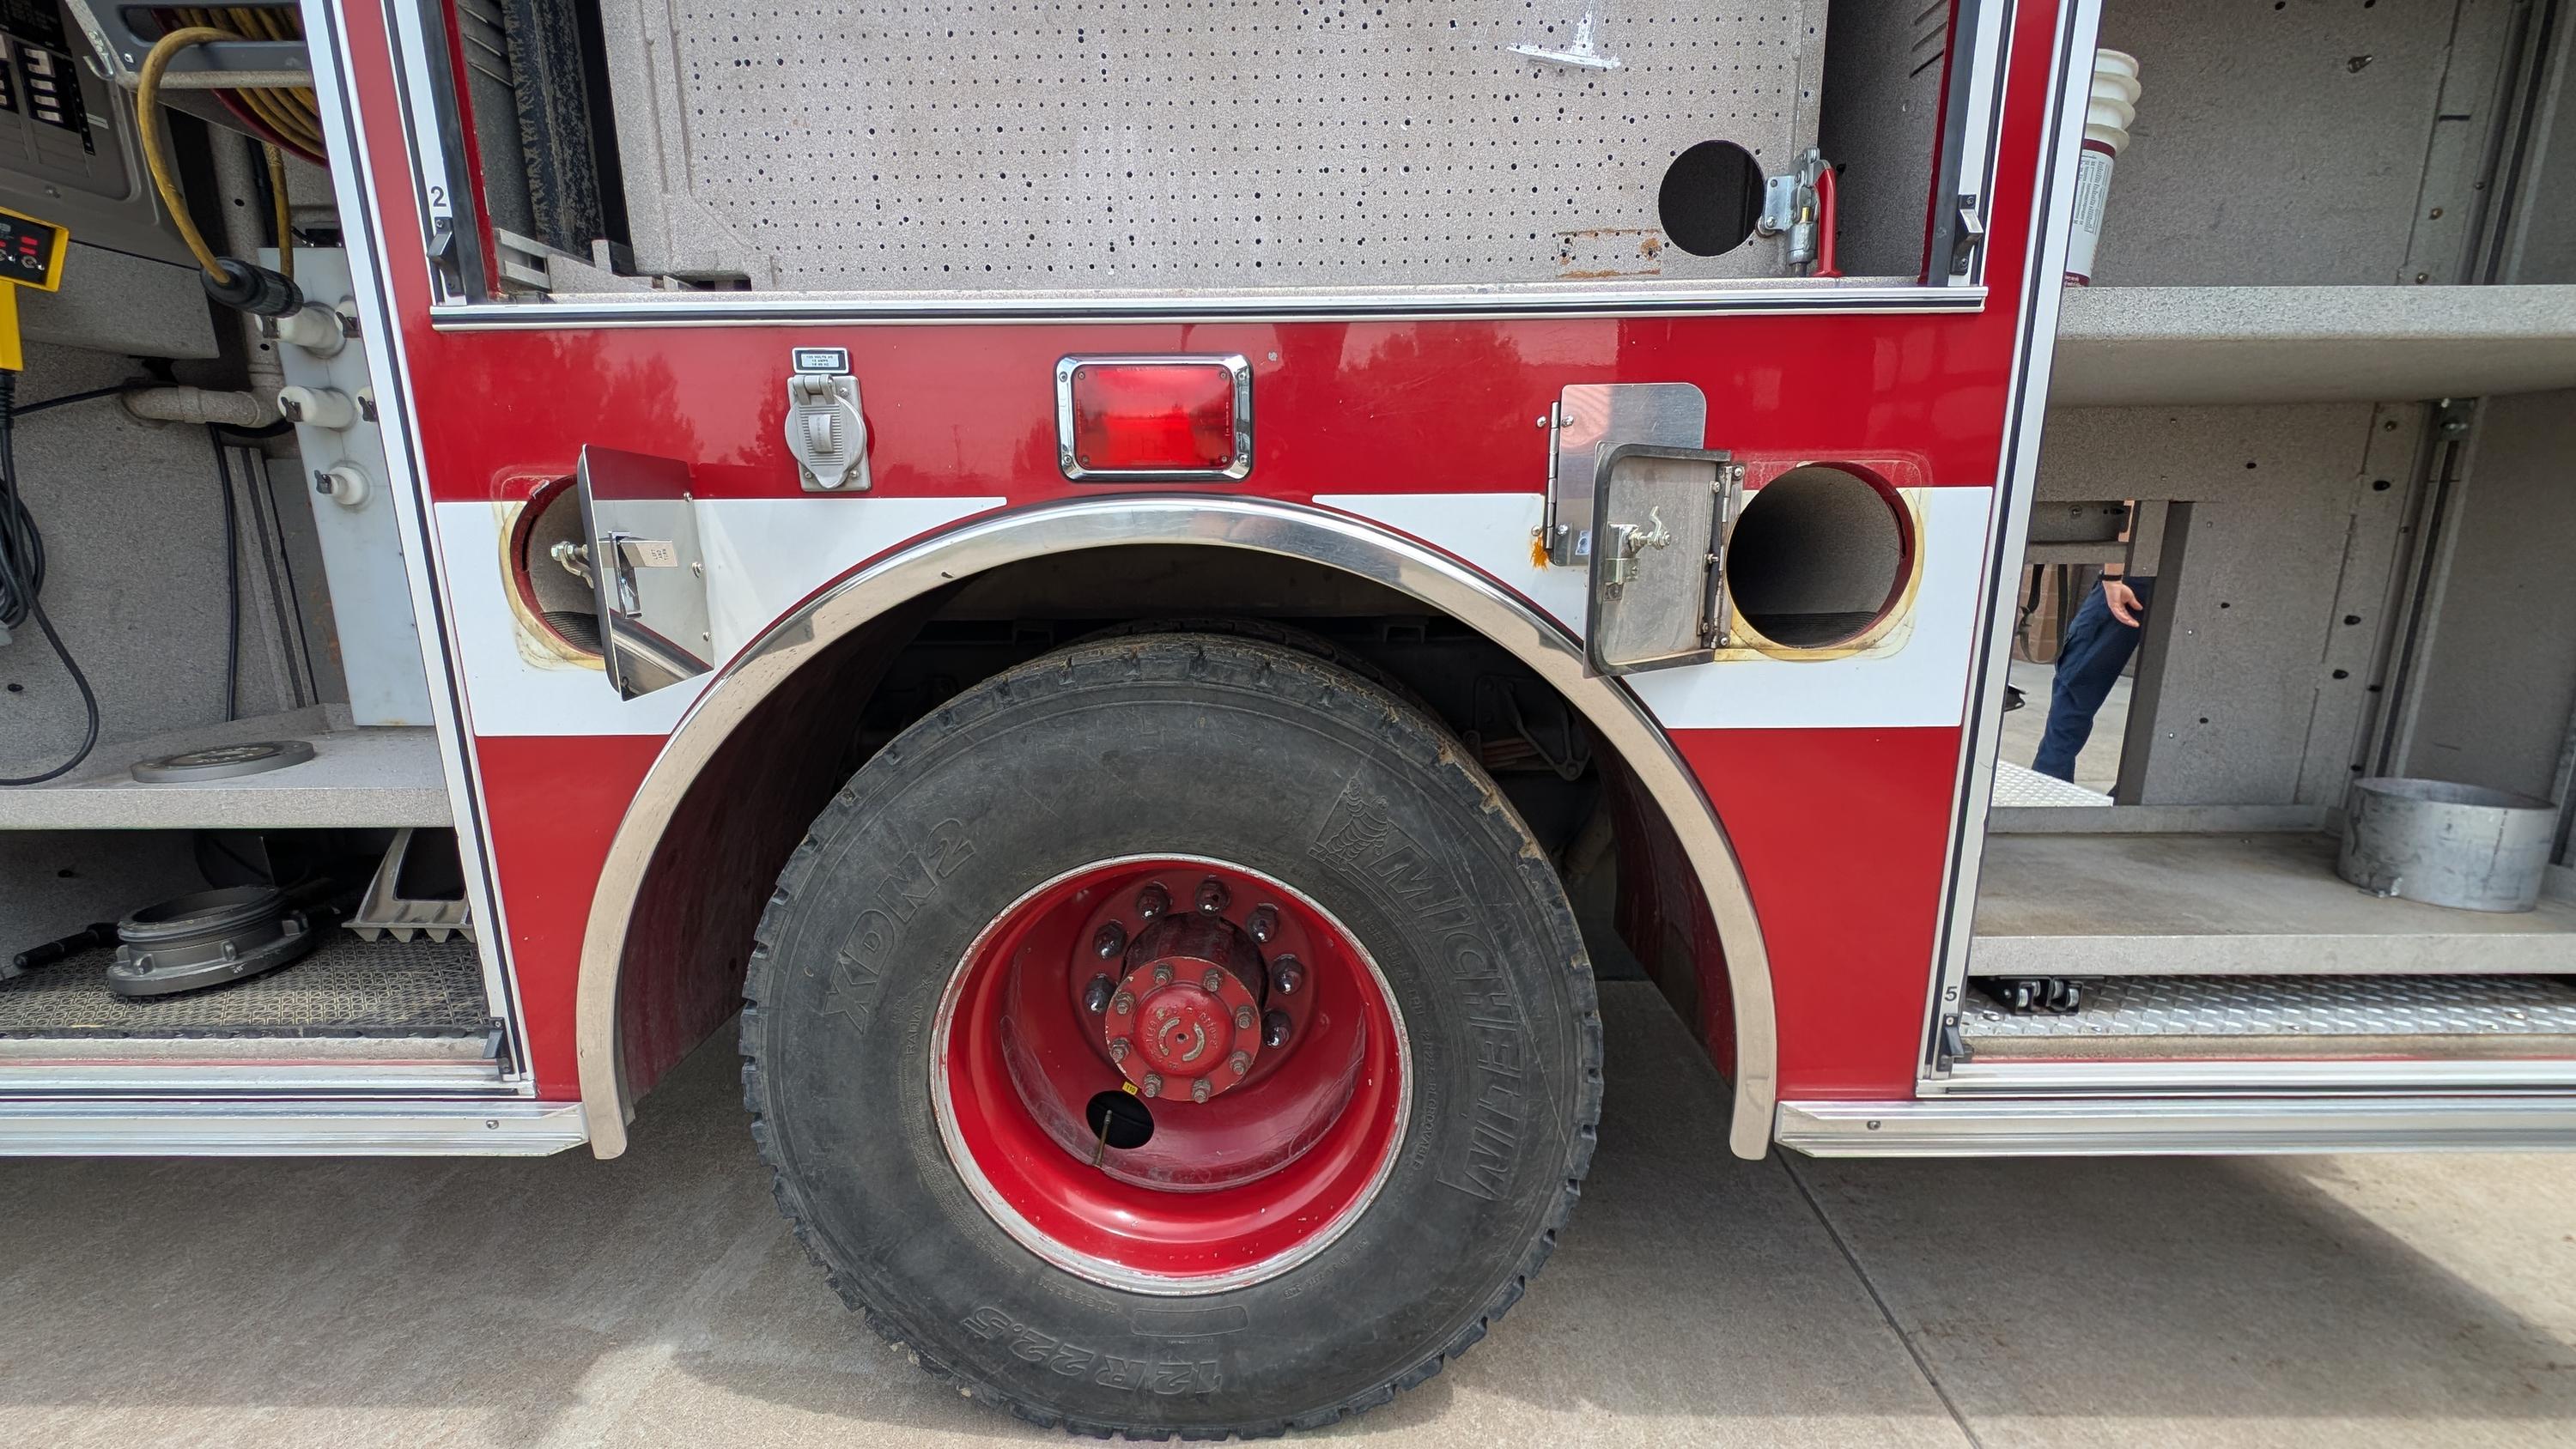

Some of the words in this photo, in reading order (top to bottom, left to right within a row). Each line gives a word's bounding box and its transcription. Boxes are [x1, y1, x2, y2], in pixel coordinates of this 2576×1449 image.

[430, 186, 447, 207] 2
[825, 818, 975, 1034] XDN2
[1364, 841, 1526, 1199] MICHELIN
[1944, 985, 1958, 1002] 5
